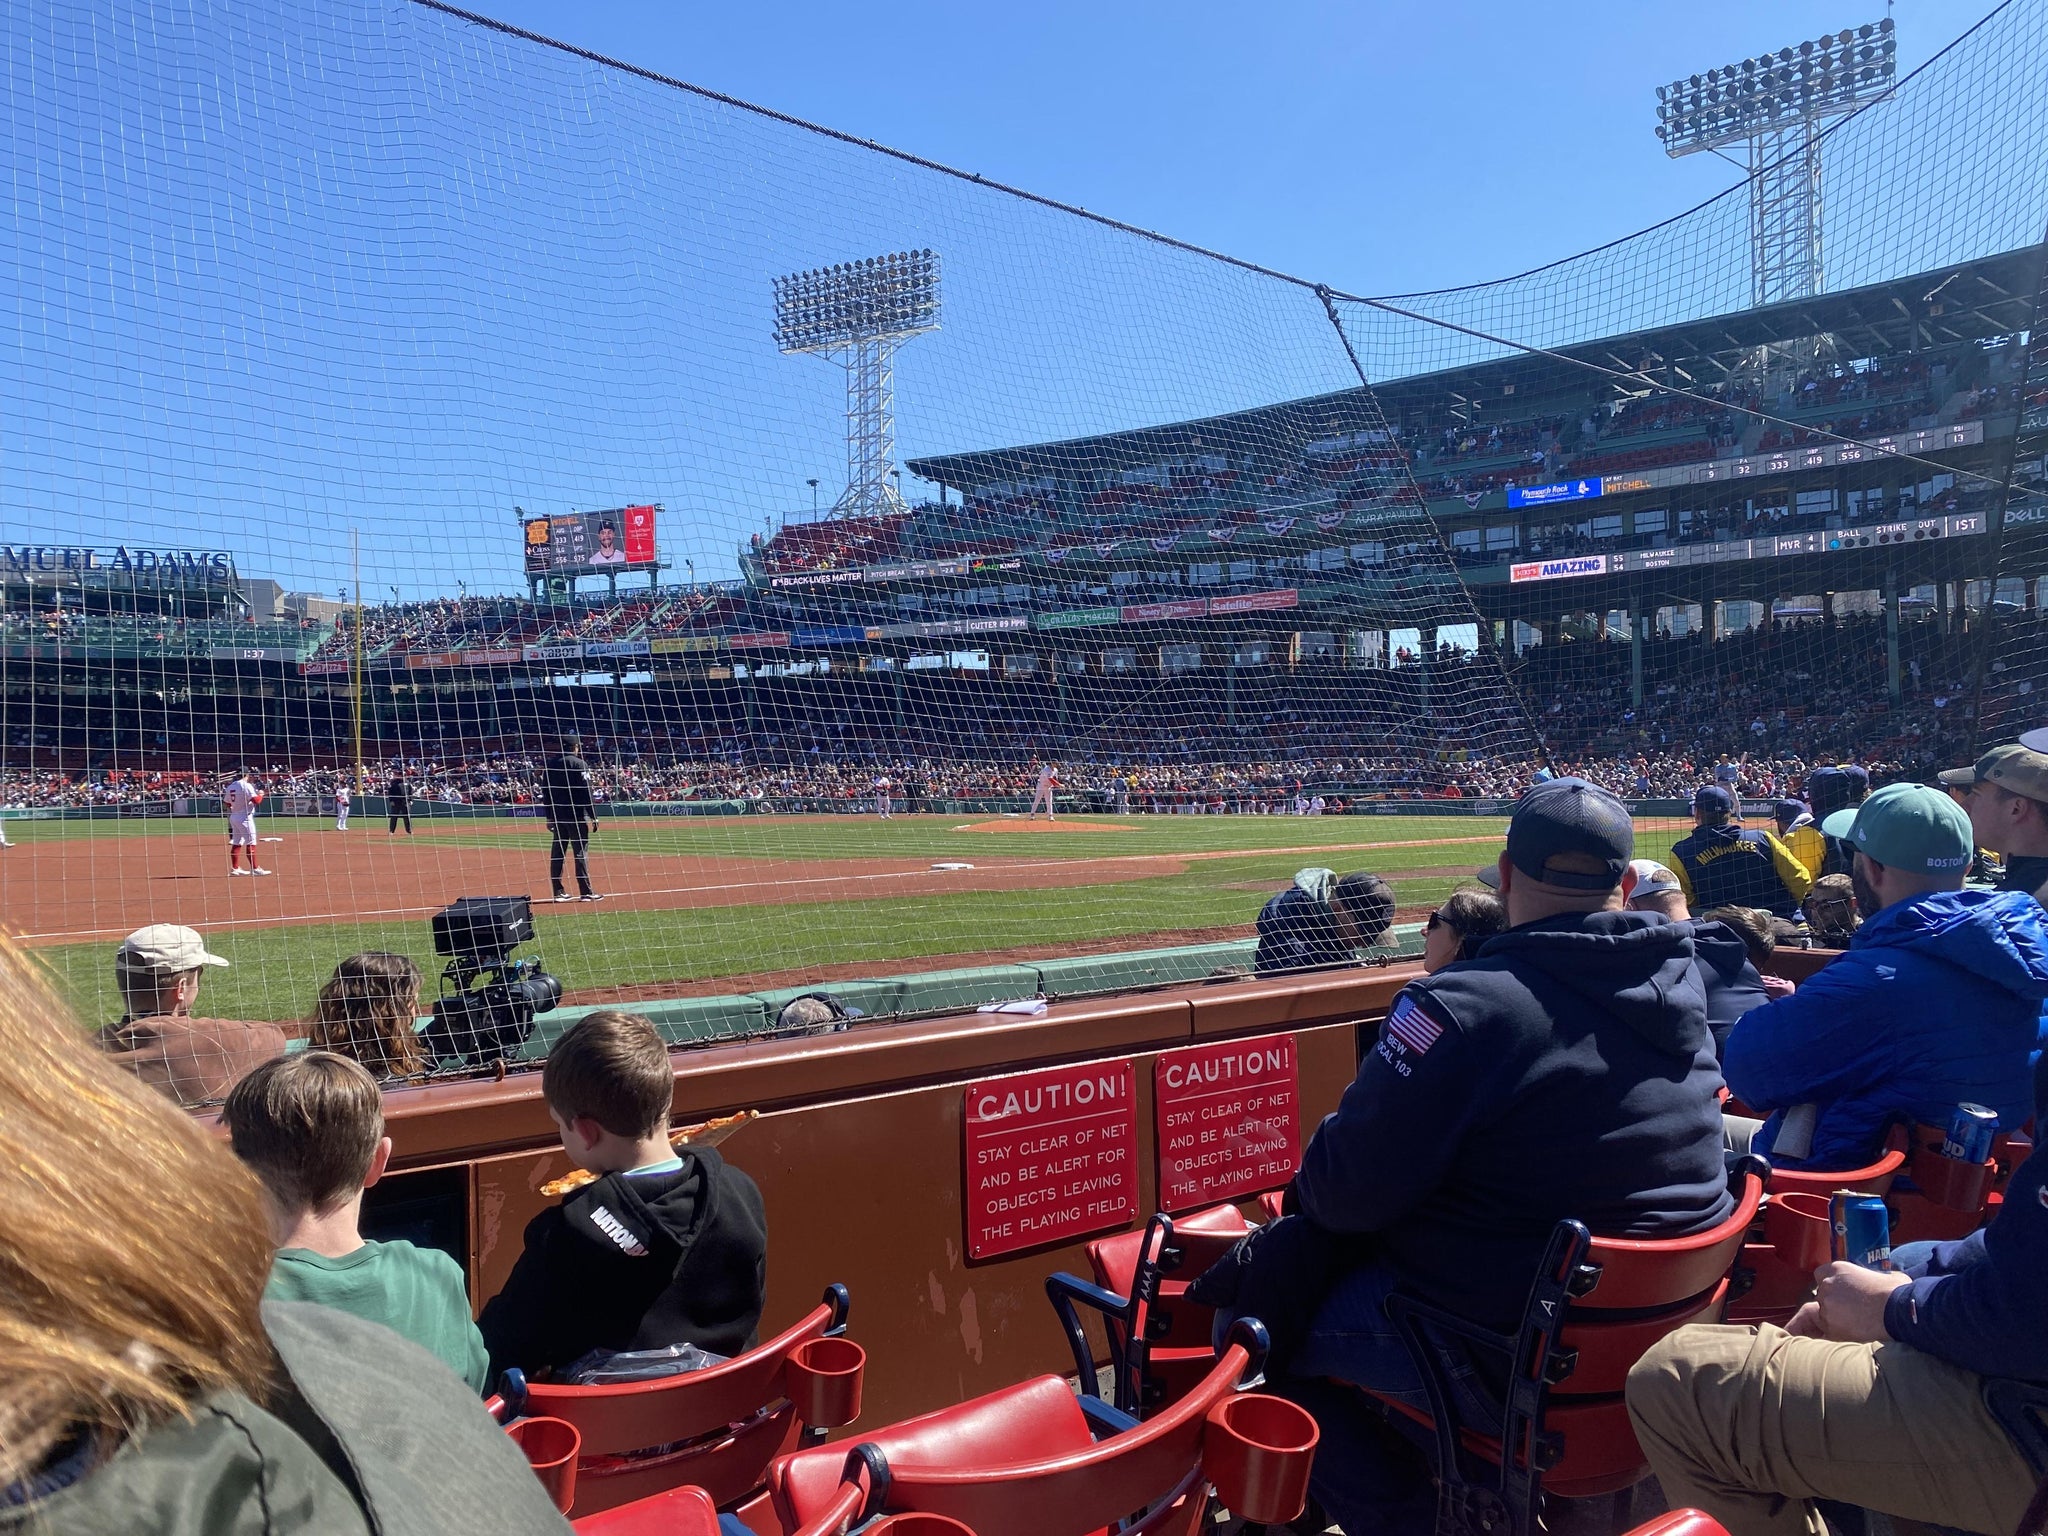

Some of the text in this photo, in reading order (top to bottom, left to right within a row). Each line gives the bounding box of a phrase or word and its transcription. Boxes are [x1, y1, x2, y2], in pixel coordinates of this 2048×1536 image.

[1954, 434, 1964, 443] 13
[1803, 456, 1822, 465] .419
[1839, 451, 1861, 460] .556
[1739, 466, 1750, 474] 32
[1522, 486, 1550, 497] Plymouth
[1552, 484, 1568, 493] Rock
[1607, 480, 1651, 492] MITCHELL
[2004, 508, 2045, 523] DELL
[1876, 523, 1907, 534] STRIKE
[1918, 519, 1936, 529] OUT
[1837, 528, 1861, 538] BALL
[1780, 540, 1800, 550] MVR
[1640, 549, 1675, 559] MILWAUKEE
[110, 544, 230, 580] ADAMS
[1542, 559, 1600, 576] AMAZING
[1645, 560, 1670, 568] BOSTON
[783, 572, 862, 586] BLACK LIVES MATTER
[1213, 600, 1252, 610] Safelite
[970, 621, 997, 629] CUTTER
[1011, 619, 1025, 627] MPH
[243, 650, 265, 658] 1:37
[422, 656, 444, 664] STIHL
[1696, 841, 1758, 865] MILWAUKEE
[1927, 857, 1964, 868] BOSTON
[1166, 1047, 1290, 1088] CAUTION!
[1395, 1059, 1412, 1077] 103
[978, 1073, 1127, 1120] CAUTION!
[1166, 1092, 1291, 1127] STAY CLEAR OF NET
[1169, 1114, 1290, 1150] AND BE ALERT FOR
[978, 1123, 1128, 1164] STAY CLEAR OF NET
[1174, 1137, 1288, 1172] OBJECTS LEAVING
[980, 1148, 1126, 1190] AND BE ALERT FOR
[1171, 1159, 1292, 1196] THE PLAYING FIELD
[986, 1173, 1122, 1214] OBJECTS LEAVING
[982, 1196, 1127, 1241] THE PLAYING FIELD
[1540, 1300, 1556, 1317] A
